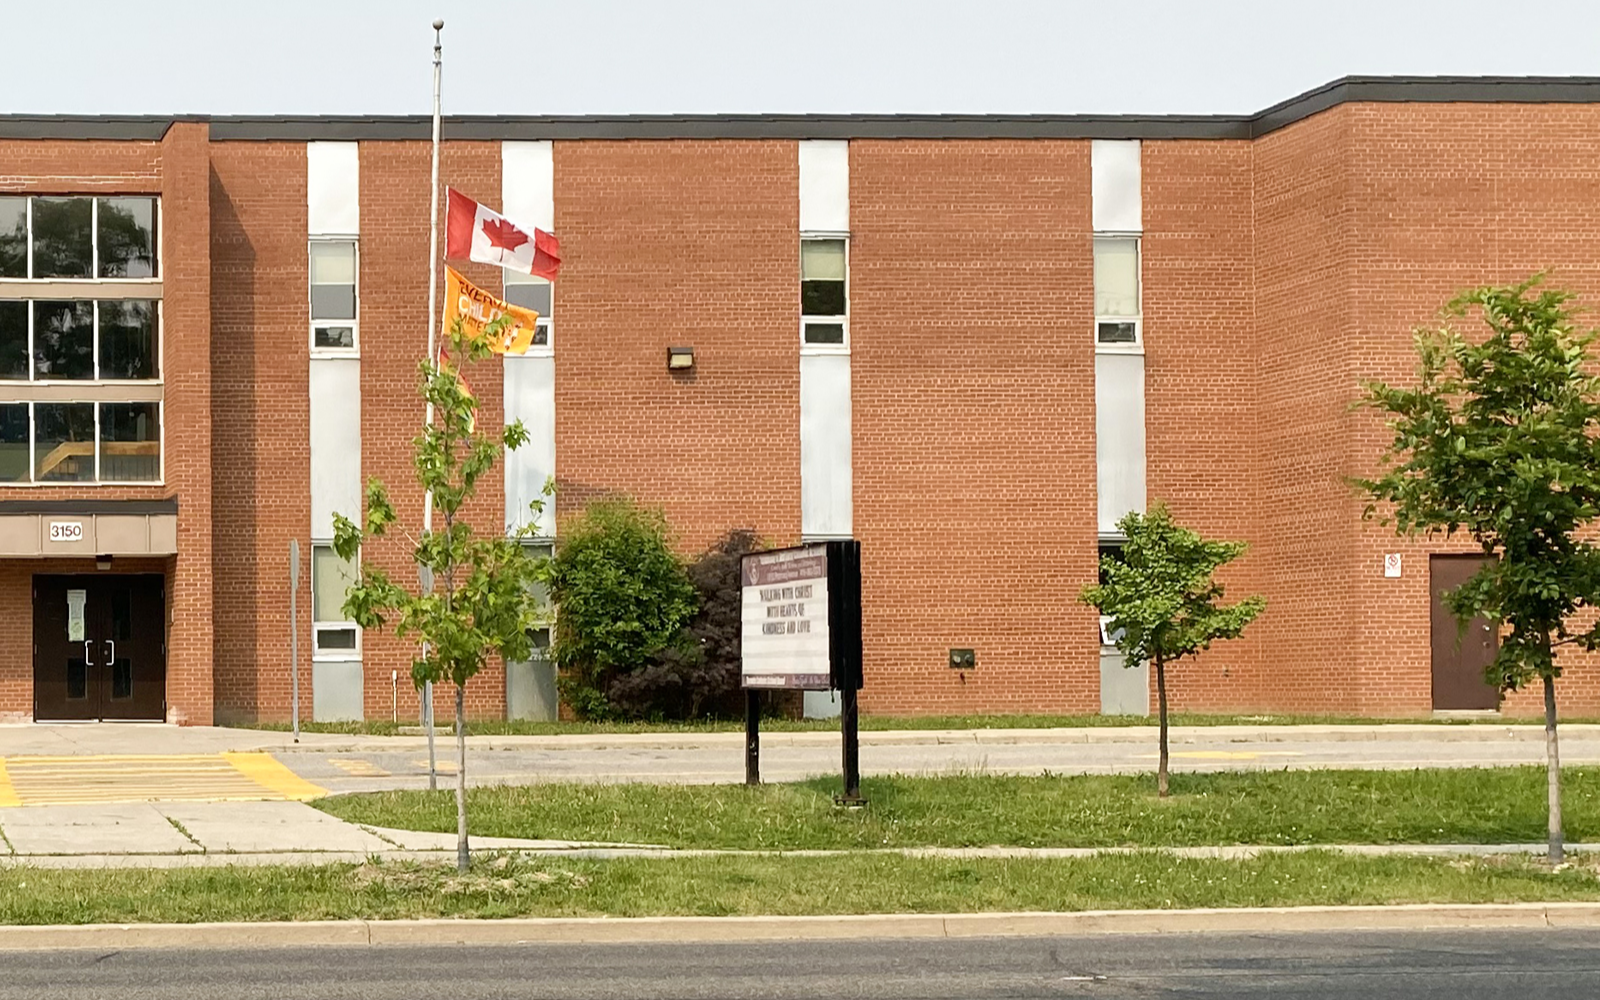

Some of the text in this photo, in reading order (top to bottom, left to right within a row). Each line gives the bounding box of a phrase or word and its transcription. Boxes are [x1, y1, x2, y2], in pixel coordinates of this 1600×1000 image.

[459, 281, 508, 310] EVERY
[459, 295, 503, 323] CHILD
[51, 525, 82, 538] 3150
